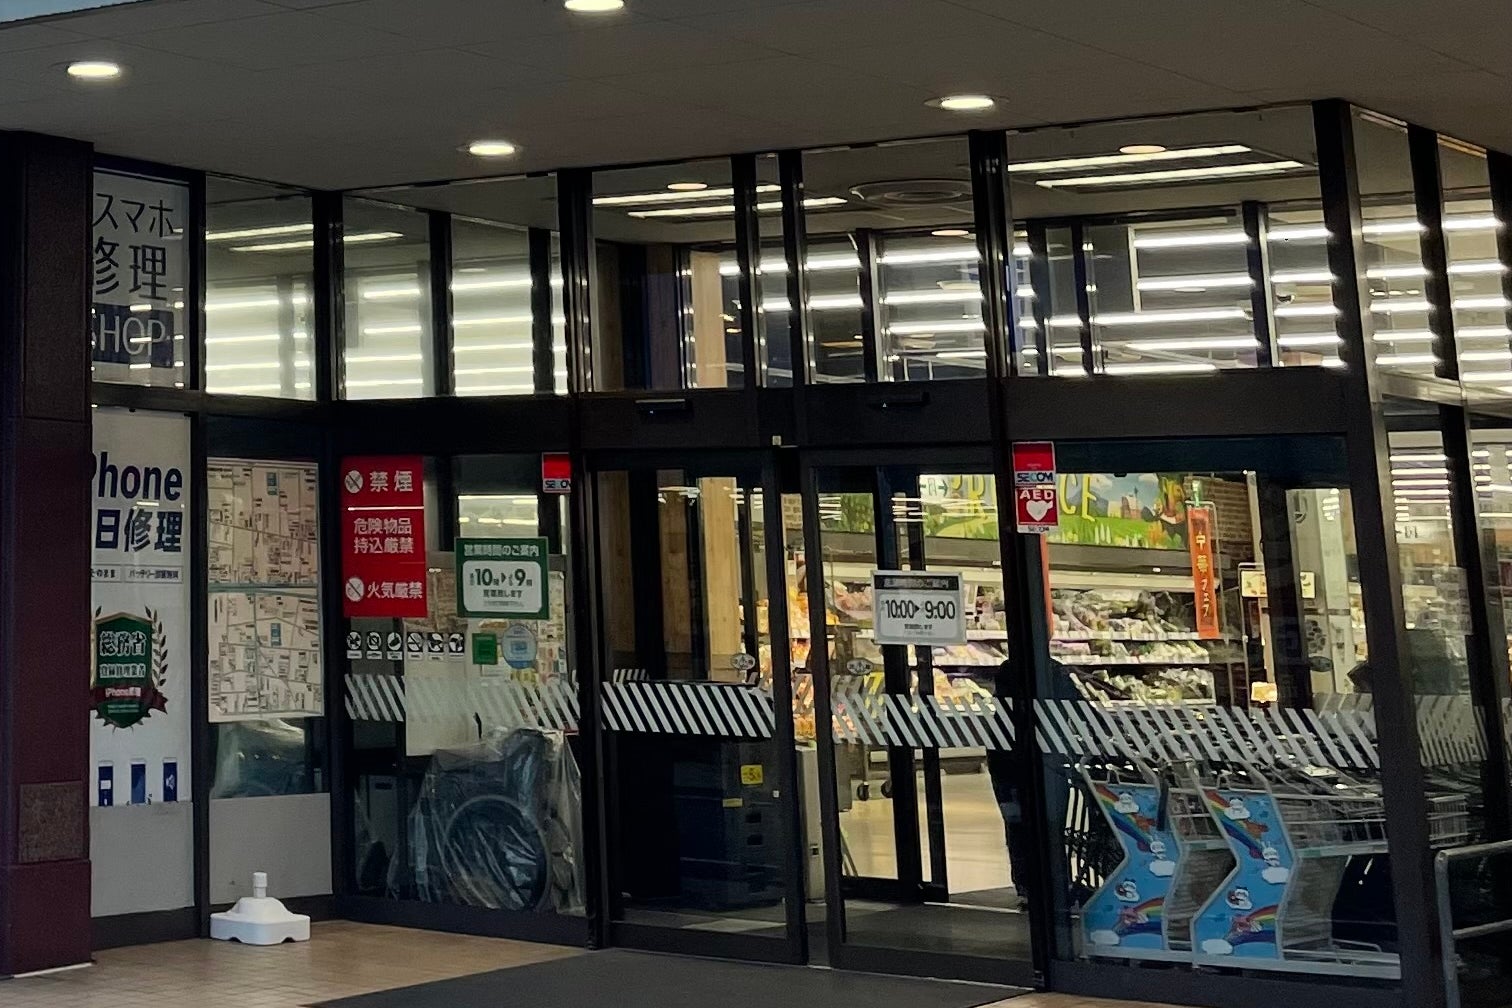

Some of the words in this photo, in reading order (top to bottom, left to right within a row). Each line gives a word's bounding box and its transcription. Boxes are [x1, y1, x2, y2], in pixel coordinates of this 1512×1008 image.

[92, 192, 174, 238] スマホ
[92, 312, 167, 356] HOP
[369, 470, 413, 492] 禁煙
[545, 480, 571, 488] SECO
[1017, 472, 1053, 482] SECOM
[1019, 489, 1054, 500] AED
[95, 508, 183, 552] 日修理
[353, 517, 412, 535] 危険物品
[353, 537, 415, 554] 持込厳禁
[367, 581, 423, 599] 火気厳禁
[924, 600, 956, 619] 9:00
[99, 630, 146, 656] 総務省
